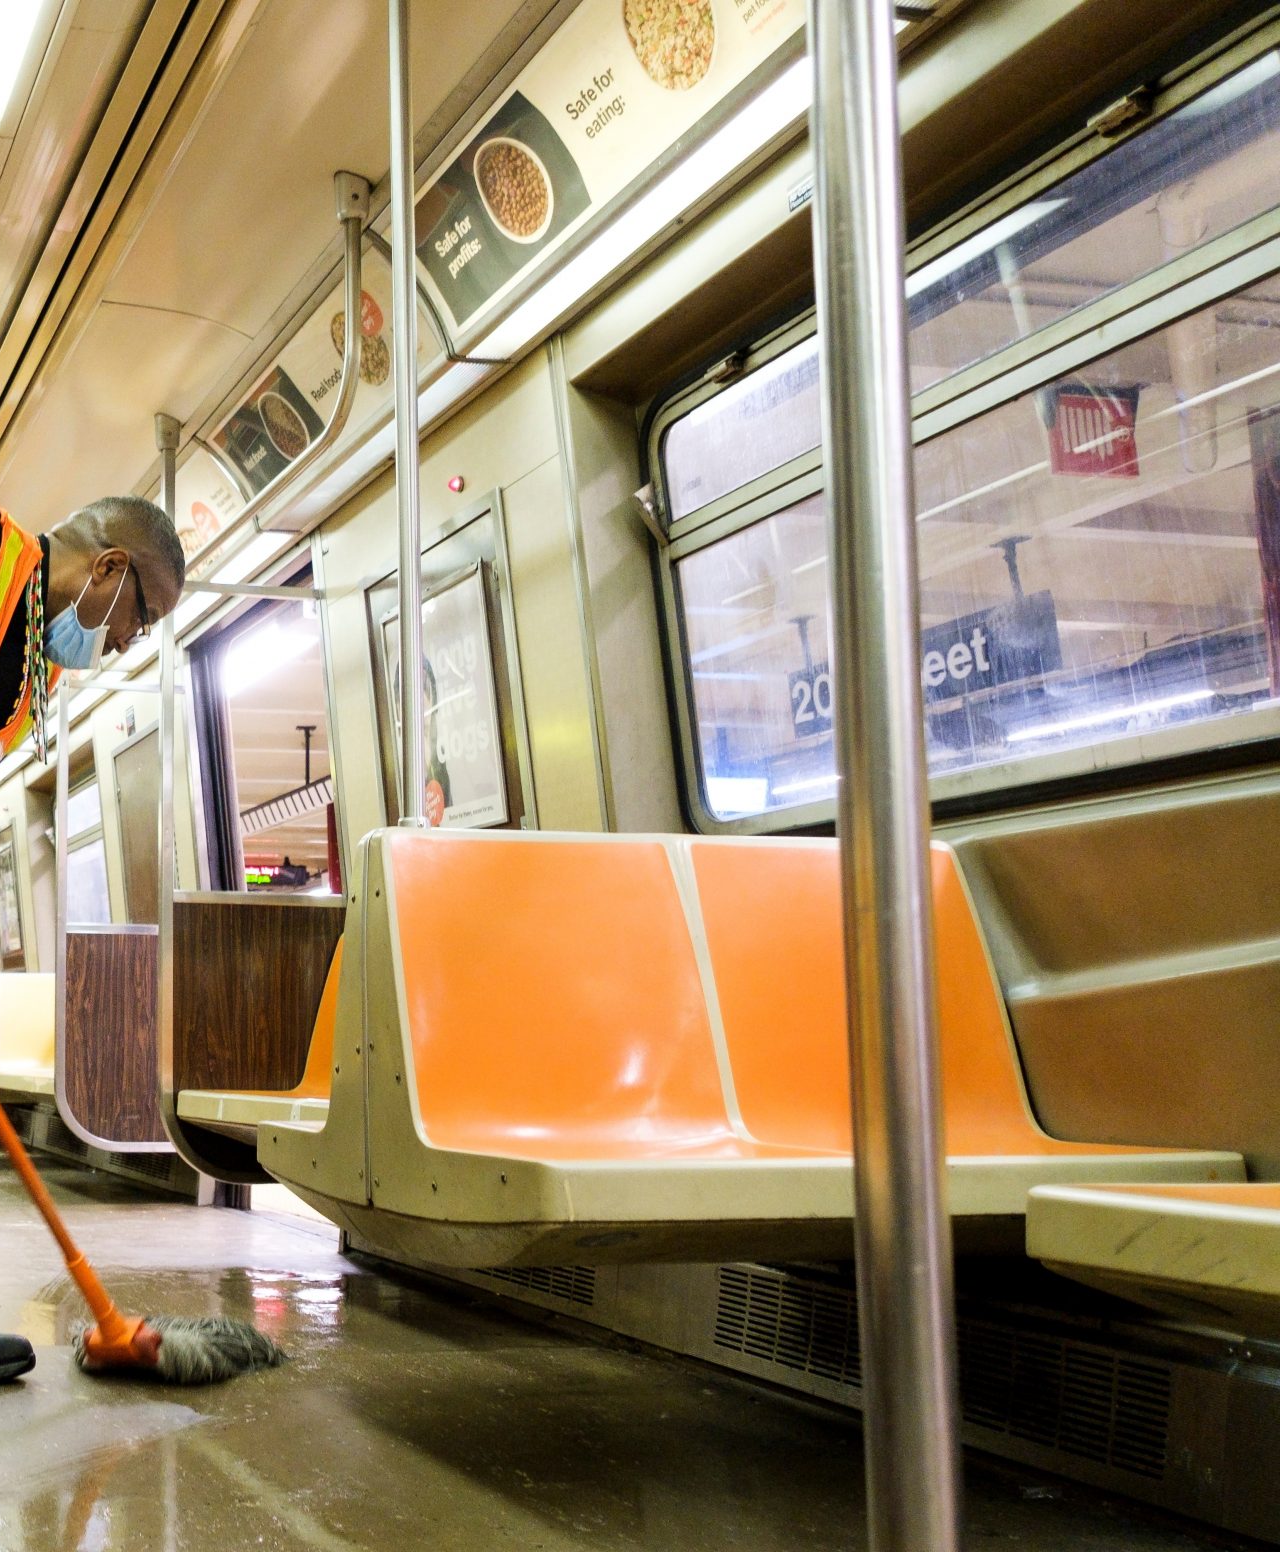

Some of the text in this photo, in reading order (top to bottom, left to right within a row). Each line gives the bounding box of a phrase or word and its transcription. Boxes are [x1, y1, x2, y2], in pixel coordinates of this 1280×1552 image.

[566, 67, 614, 120] Safe for
[586, 95, 625, 138] eating:
[435, 215, 471, 257] Safe for
[448, 238, 482, 279] profits:
[311, 382, 329, 402] Real
[792, 627, 990, 725] 20 eet
